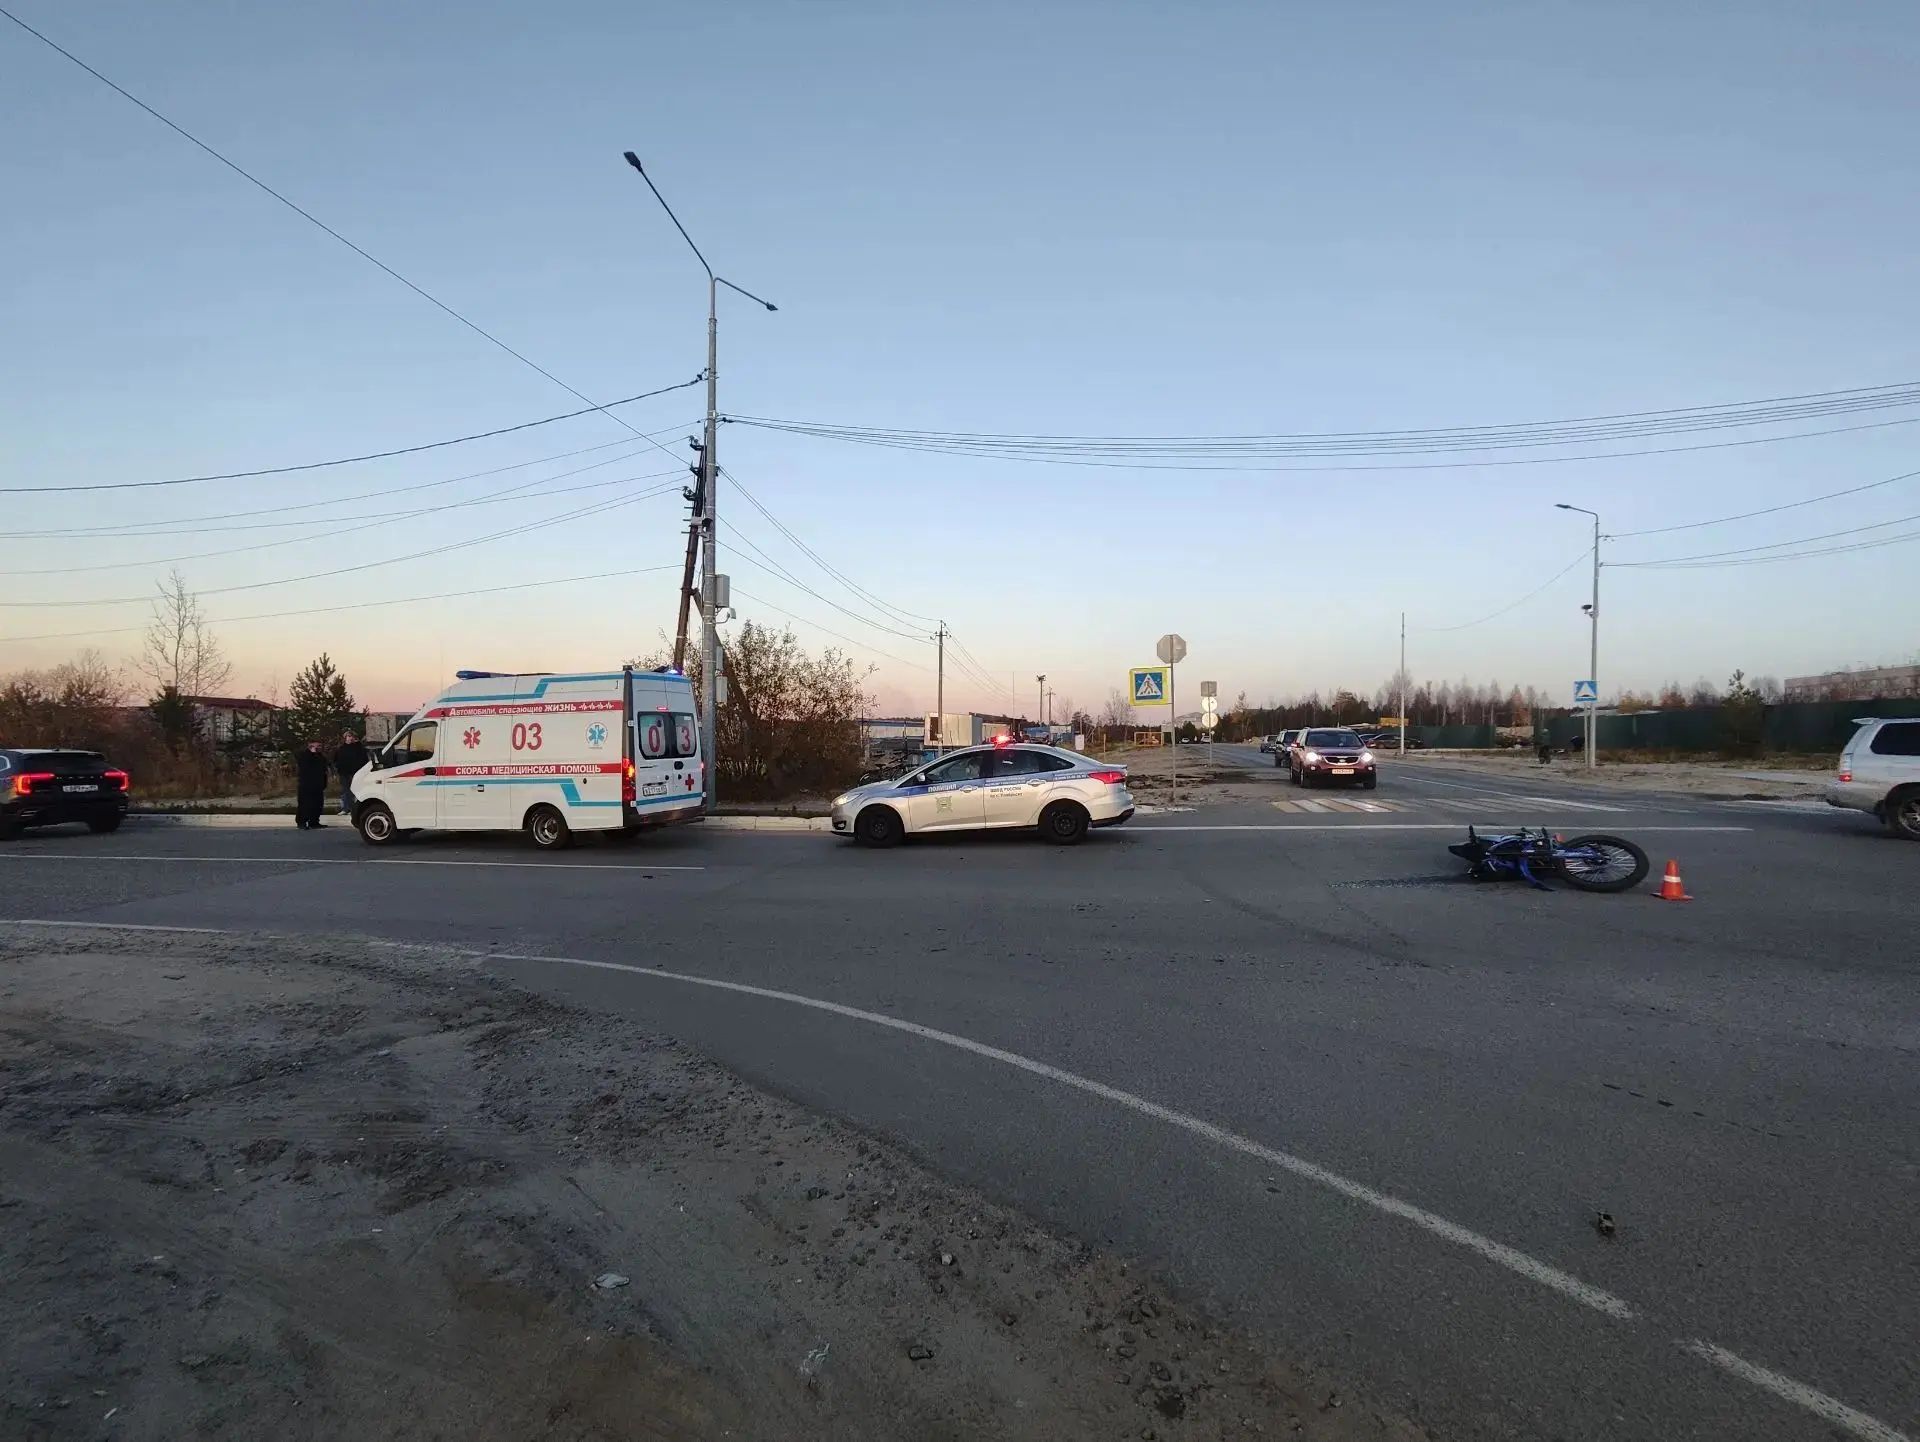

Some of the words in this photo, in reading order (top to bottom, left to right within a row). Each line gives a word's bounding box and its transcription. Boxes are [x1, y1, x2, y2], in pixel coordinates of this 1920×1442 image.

[544, 703, 576, 712] ЖИЗНЬ
[512, 722, 542, 750] 03
[456, 767, 488, 775] СКОРАЯ
[492, 765, 556, 775] МЕДИЦИНСКАЯ
[560, 764, 601, 773] ПОМОЩЬ
[928, 784, 957, 793] ПОЛИЦИЯ
